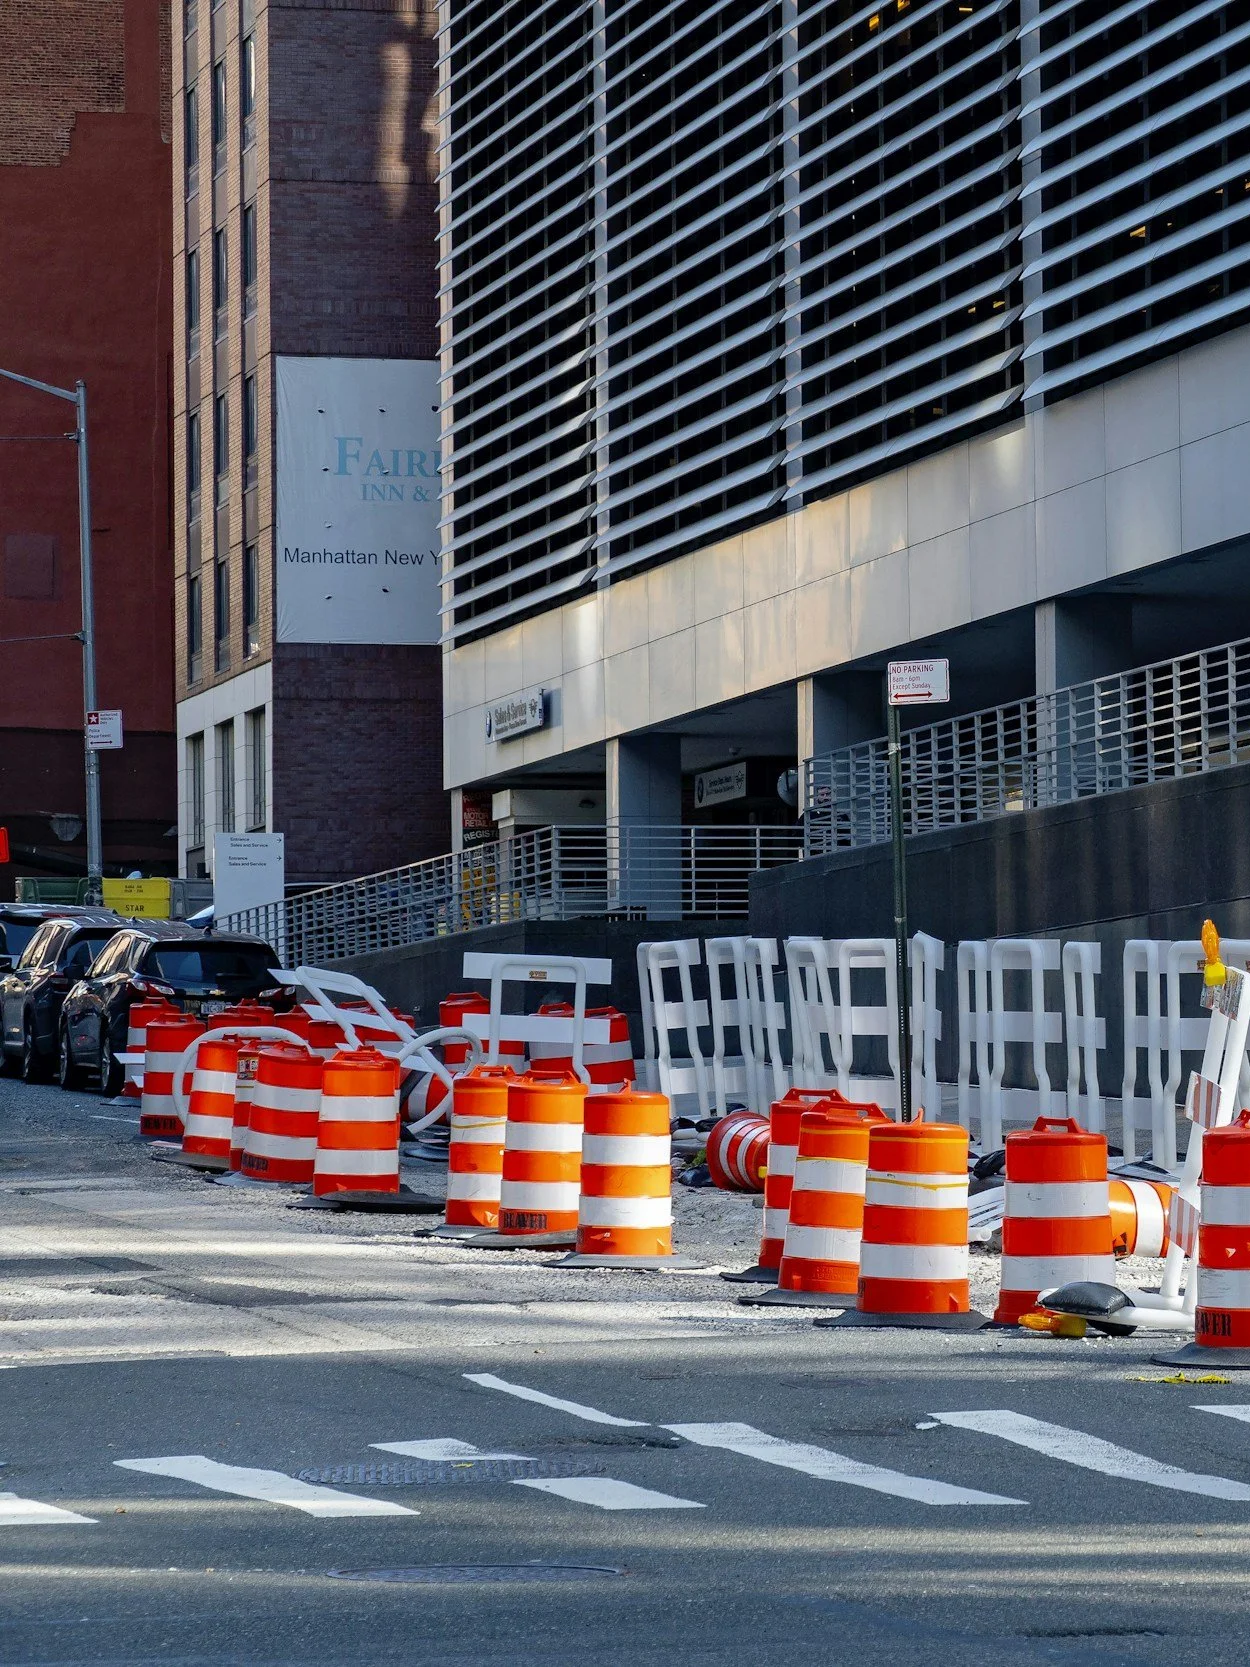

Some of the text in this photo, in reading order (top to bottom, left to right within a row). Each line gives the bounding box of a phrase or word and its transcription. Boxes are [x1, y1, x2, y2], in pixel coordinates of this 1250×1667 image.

[361, 483, 432, 502] INN &
[284, 548, 378, 565] Manhattan
[385, 550, 424, 565] New
[891, 664, 934, 674] NO PARKING
[911, 682, 931, 690] Sunday
[463, 811, 489, 821] MOTOR
[125, 904, 145, 912] STAR
